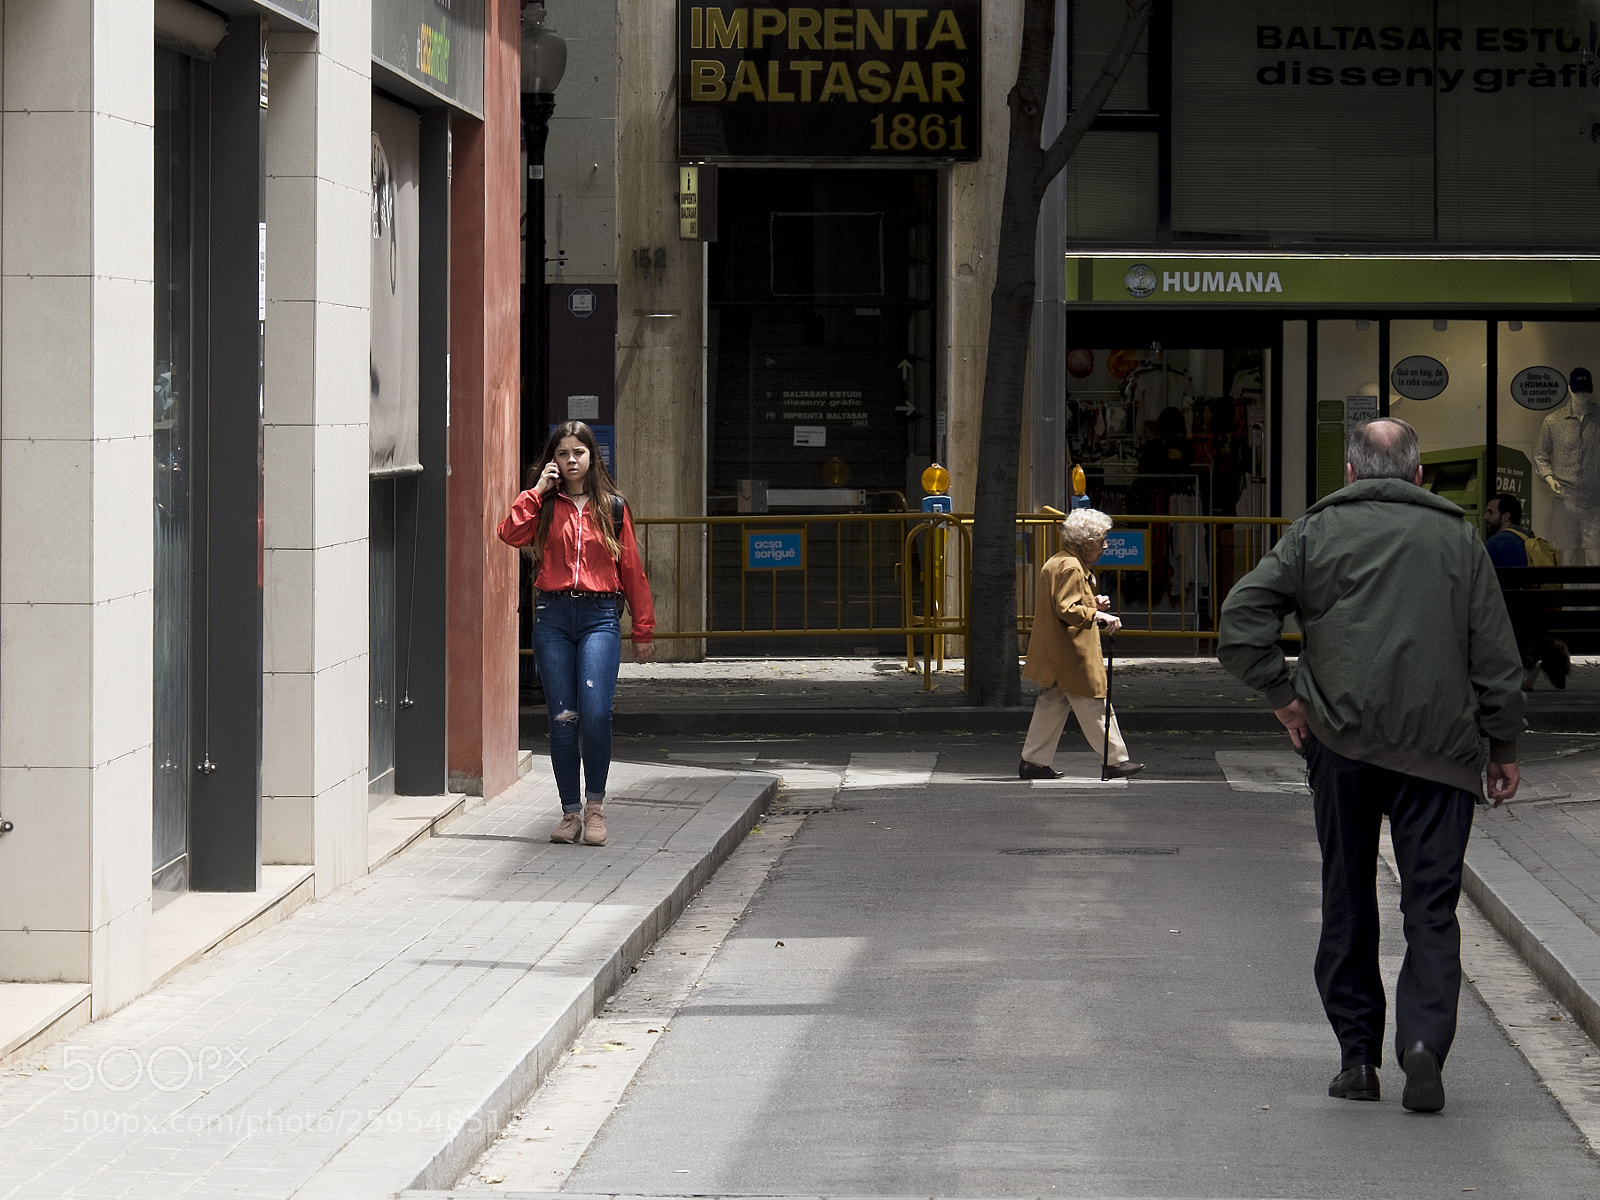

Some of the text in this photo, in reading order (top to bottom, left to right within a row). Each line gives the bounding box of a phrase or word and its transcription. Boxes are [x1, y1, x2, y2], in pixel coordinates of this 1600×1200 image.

[690, 7, 968, 51] IMPRENTA
[1256, 26, 1463, 52] BALTASAR
[690, 59, 967, 104] BALTASAR
[1256, 61, 1465, 93] disseny
[869, 112, 968, 152] 1861
[633, 247, 667, 269] 152
[1163, 271, 1283, 293] HUMANA
[1406, 378, 1419, 386] roba
[783, 390, 828, 398] BALTASAR
[829, 390, 863, 398] ESTUDI
[1496, 476, 1516, 492] OBA
[754, 540, 783, 549] acsa
[1105, 538, 1125, 546] csa
